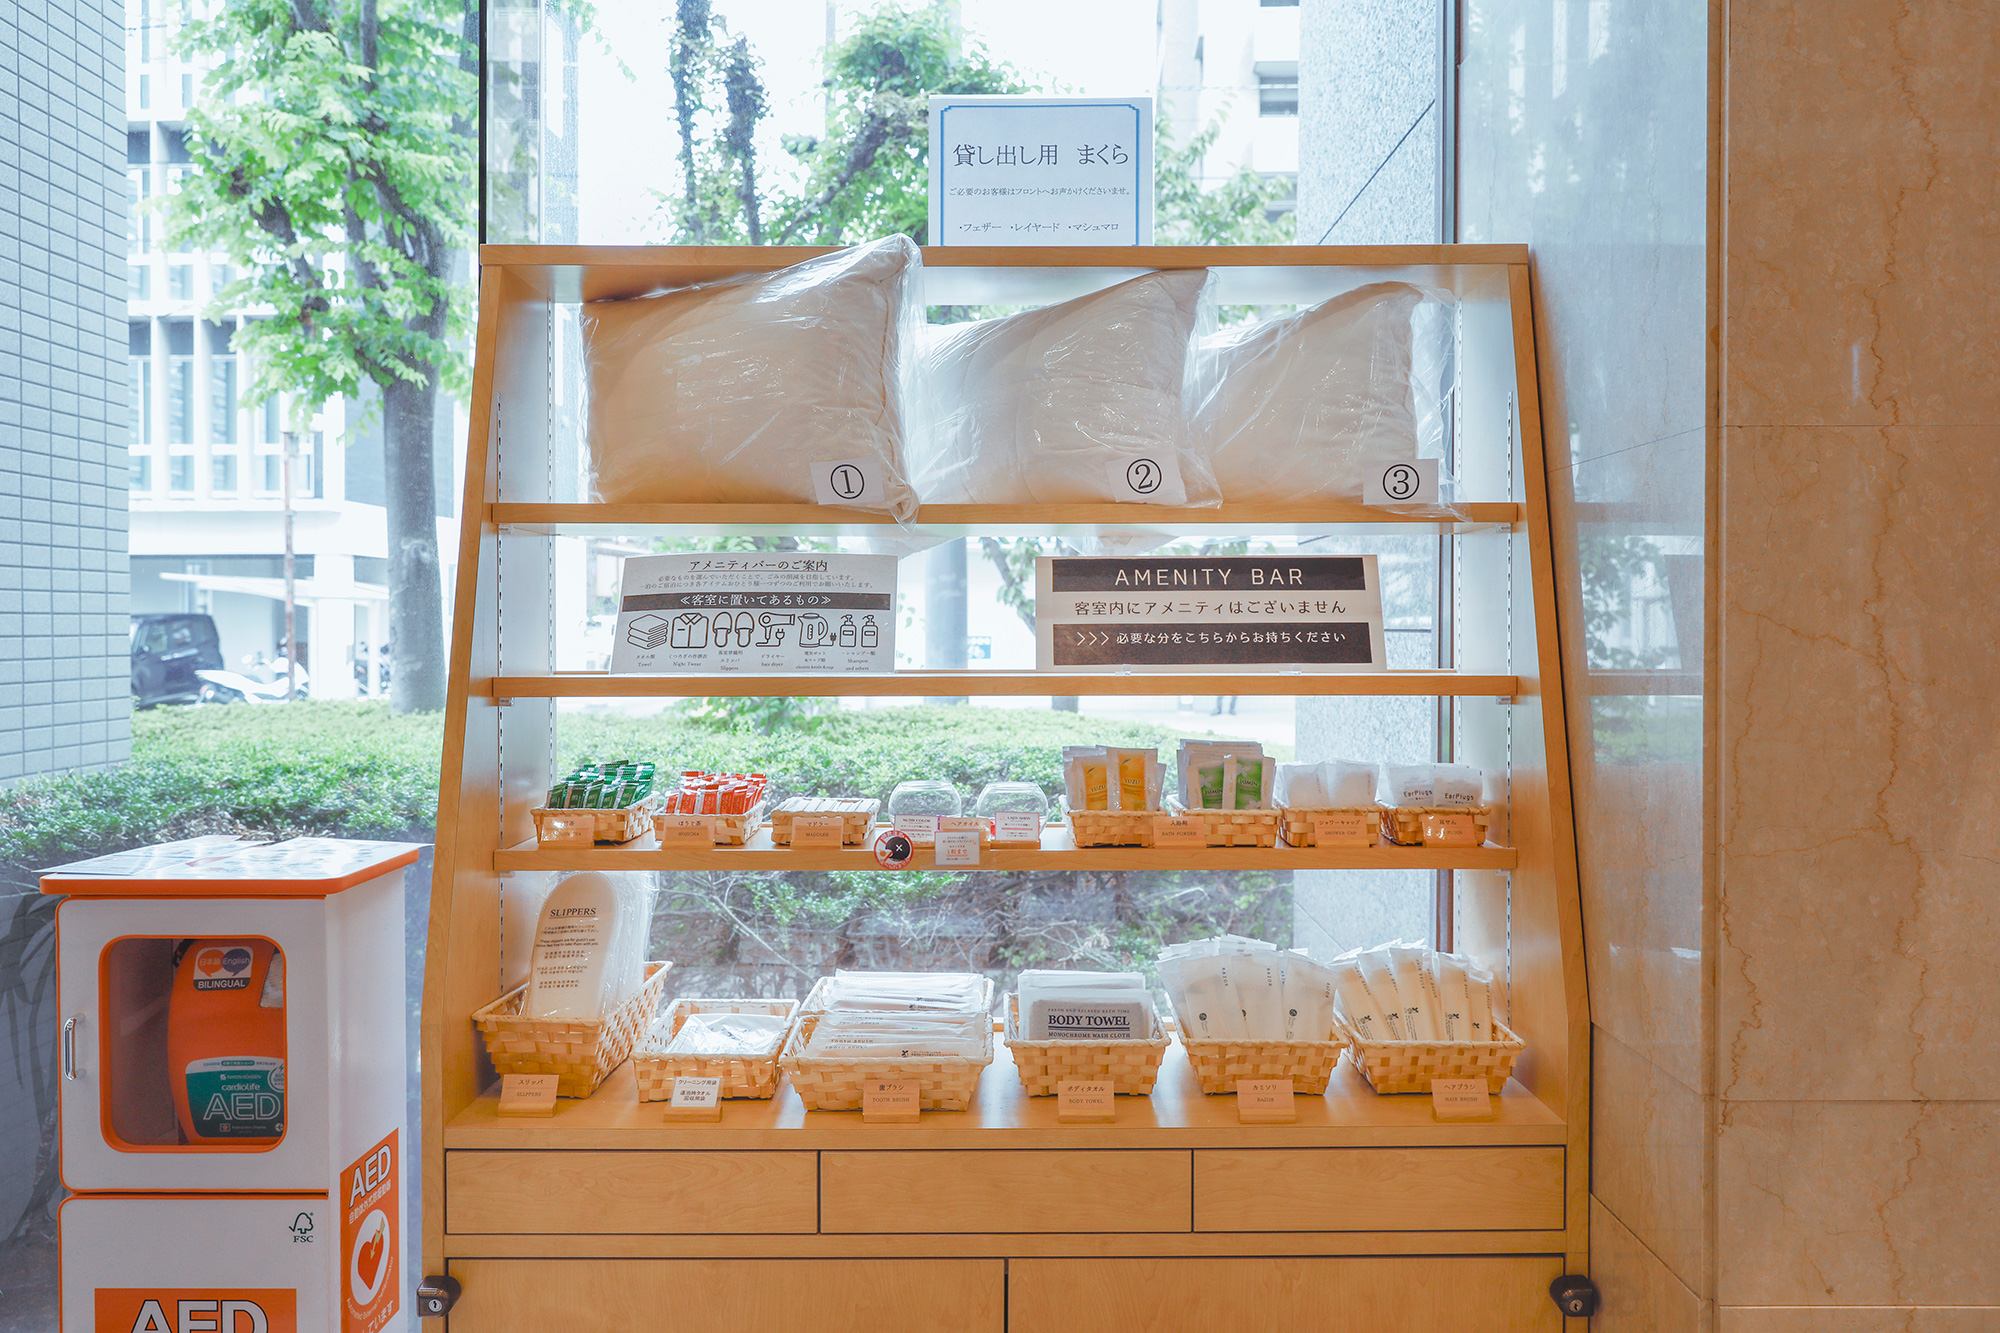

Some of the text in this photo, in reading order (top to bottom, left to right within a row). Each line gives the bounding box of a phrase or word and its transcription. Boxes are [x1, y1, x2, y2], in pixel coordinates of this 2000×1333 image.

[953, 143, 1129, 167] 貸し出し用 まくら
[690, 560, 828, 571] アメニティバーのご案内
[1115, 568, 1303, 586] AMENITY BAR
[1075, 600, 1346, 616] 客室内にアメニティはございません
[1116, 630, 1346, 645] 必要な分をこちらからお持ちください
[1403, 789, 1433, 798] EarPlugs
[1444, 792, 1474, 801] EarPlugs
[550, 908, 597, 917] SLIPPERS
[222, 957, 250, 965] English
[1221, 967, 1229, 987] RAZOR
[197, 979, 246, 989] BILINGUAL
[1048, 1014, 1130, 1026] BODY TOWEL
[203, 1092, 281, 1120] AED
[349, 1144, 392, 1209] AED
[293, 1235, 314, 1243] FSC
[131, 1299, 269, 1333] AED
